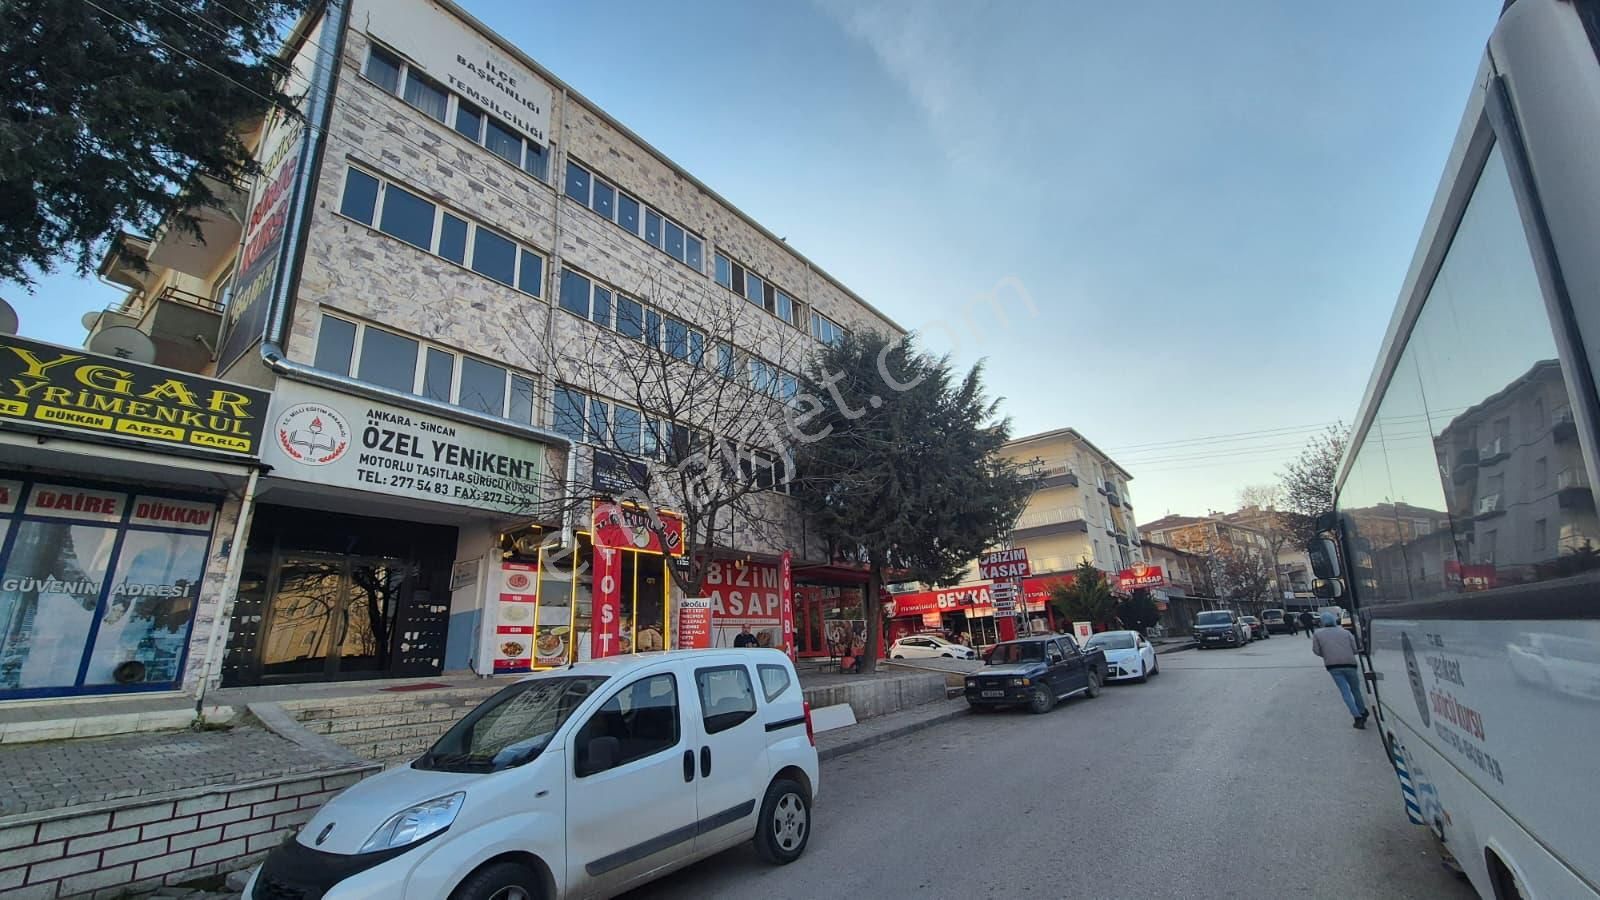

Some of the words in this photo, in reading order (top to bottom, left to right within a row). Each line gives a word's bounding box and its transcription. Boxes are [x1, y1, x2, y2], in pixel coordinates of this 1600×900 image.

[456, 54, 540, 115] BAŞKANLIĞI
[0, 344, 254, 419] YGAR
[0, 378, 250, 436] YRİMENKUL
[366, 409, 411, 427] ANKARA
[45, 409, 104, 427] DÜKKAN
[126, 423, 176, 438] ARSA
[194, 434, 246, 450] TARLA
[362, 419, 424, 459] ÖZEL
[357, 469, 387, 485] TEL:
[390, 475, 415, 489] 277
[417, 479, 432, 492] 54
[434, 482, 449, 495] 83
[454, 486, 480, 500] FAX:
[359, 453, 414, 473] MOTORLU
[416, 464, 465, 483] TAŞITLAR
[466, 473, 504, 490] SÜRÜCÜ
[505, 480, 535, 495] KURSU
[35, 491, 117, 515] DAİRE
[135, 503, 211, 526] DÜKKAN
[980, 562, 1027, 580] KASAP
[1136, 575, 1163, 585] KASAP
[2, 576, 101, 595] GÜVENİN
[112, 583, 191, 600] ADRESİ
[599, 547, 616, 653] TOST
[700, 589, 779, 616] ASAP
[937, 590, 965, 609] BEY
[783, 556, 792, 656] ÇORBA
